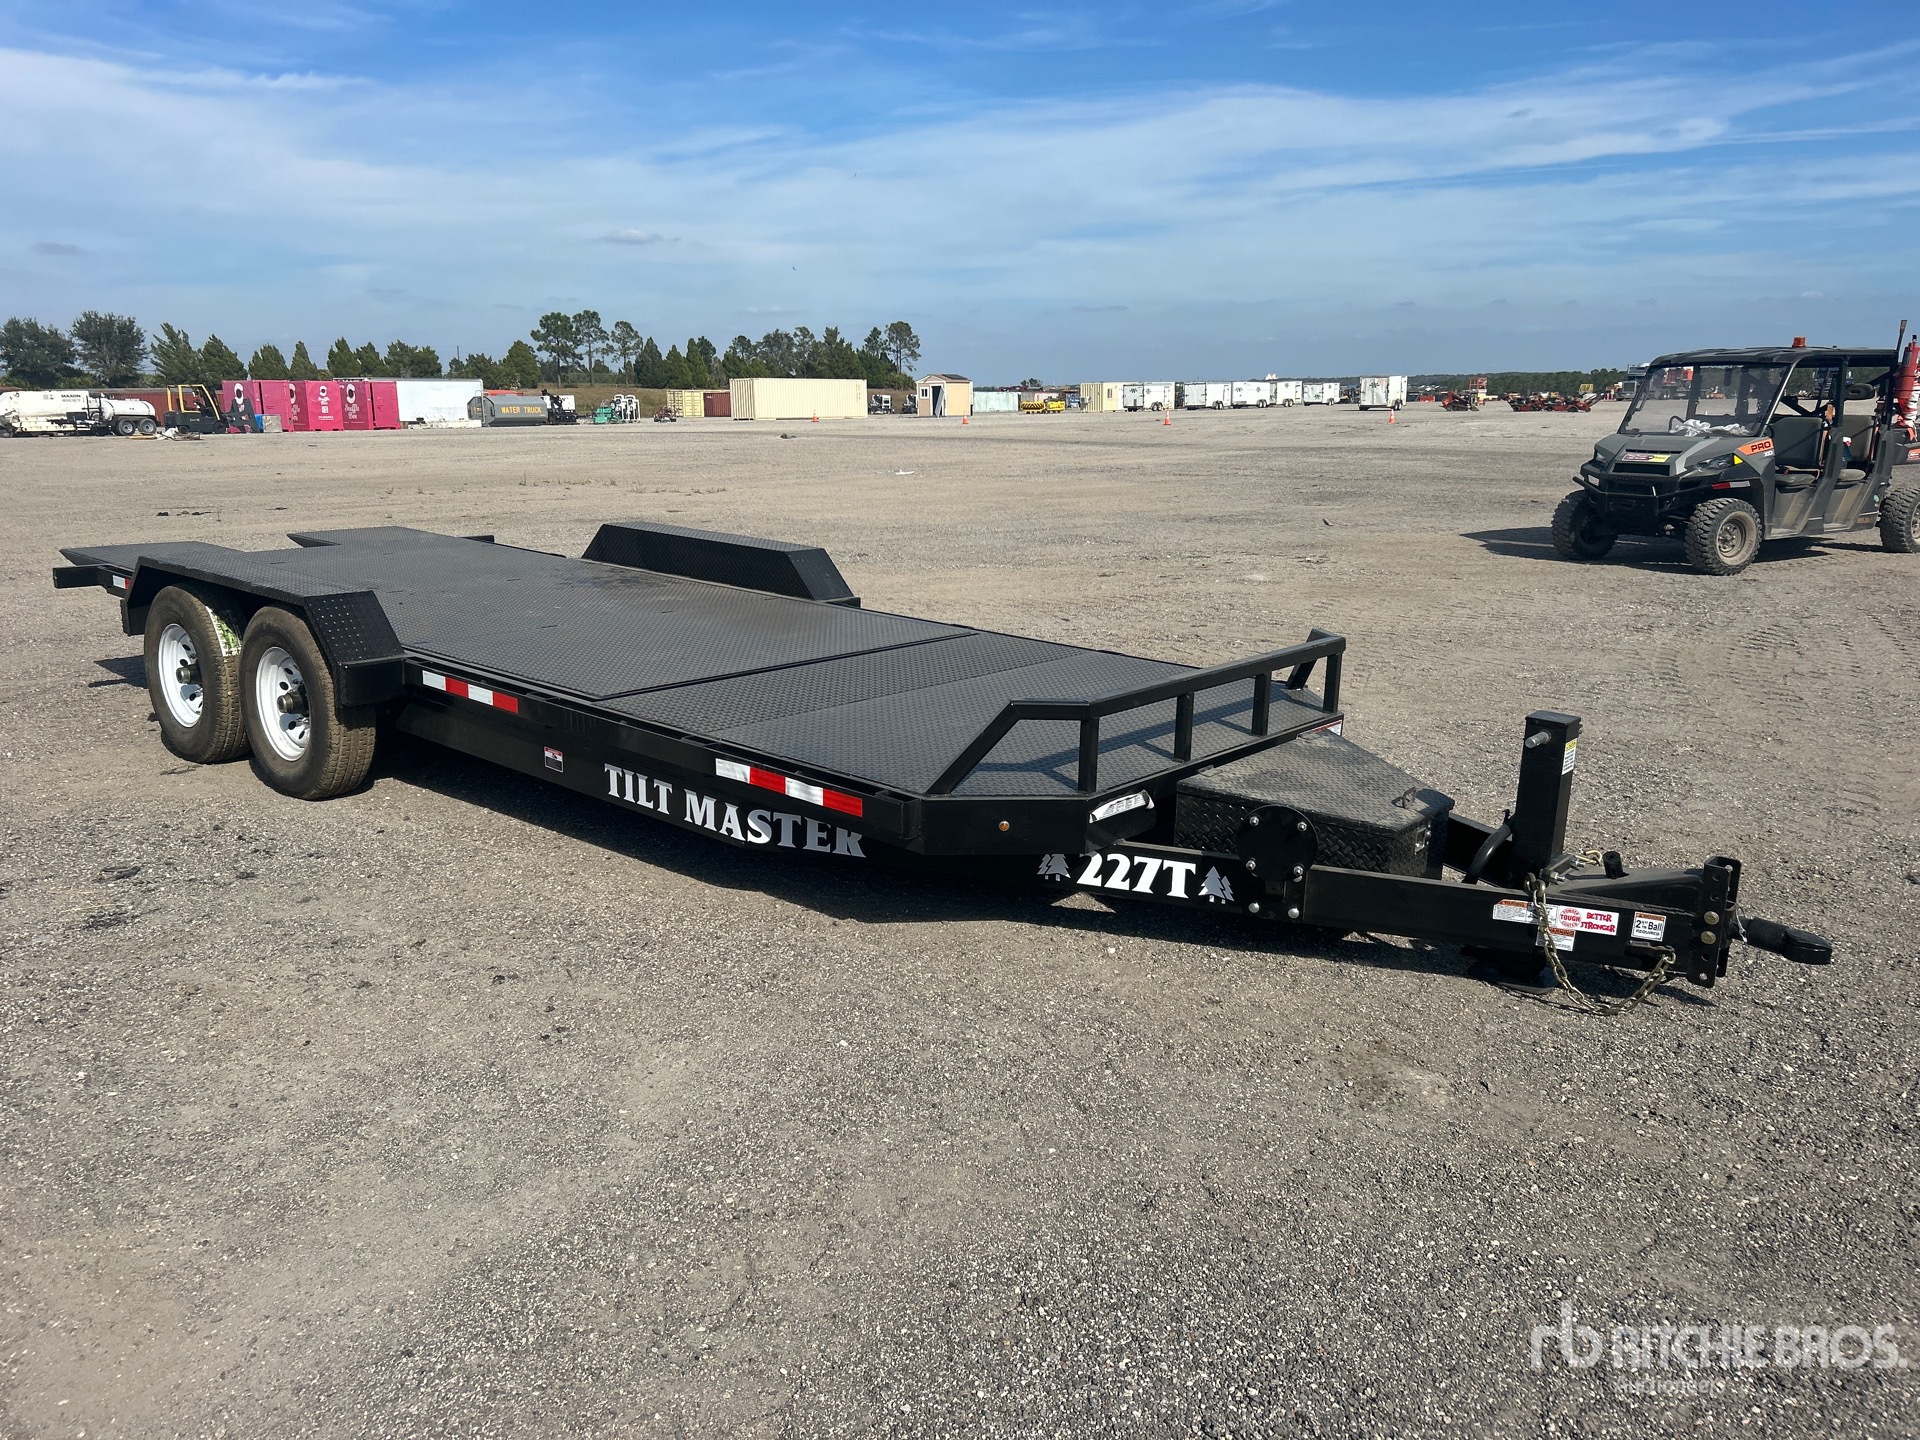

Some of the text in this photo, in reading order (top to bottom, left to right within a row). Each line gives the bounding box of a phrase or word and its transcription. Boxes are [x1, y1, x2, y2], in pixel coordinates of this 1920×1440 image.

[501, 406, 542, 414] WATER TRUCK
[1750, 441, 1771, 452] PRO
[604, 763, 673, 815] TILT
[684, 789, 867, 859] MASTER
[1076, 851, 1196, 899] 227T
[1560, 913, 1581, 922] TOUGH
[1586, 912, 1612, 922] BETTER
[1580, 921, 1616, 933] STRONGER
[1636, 919, 1642, 929] 2
[1648, 921, 1662, 931] Ball
